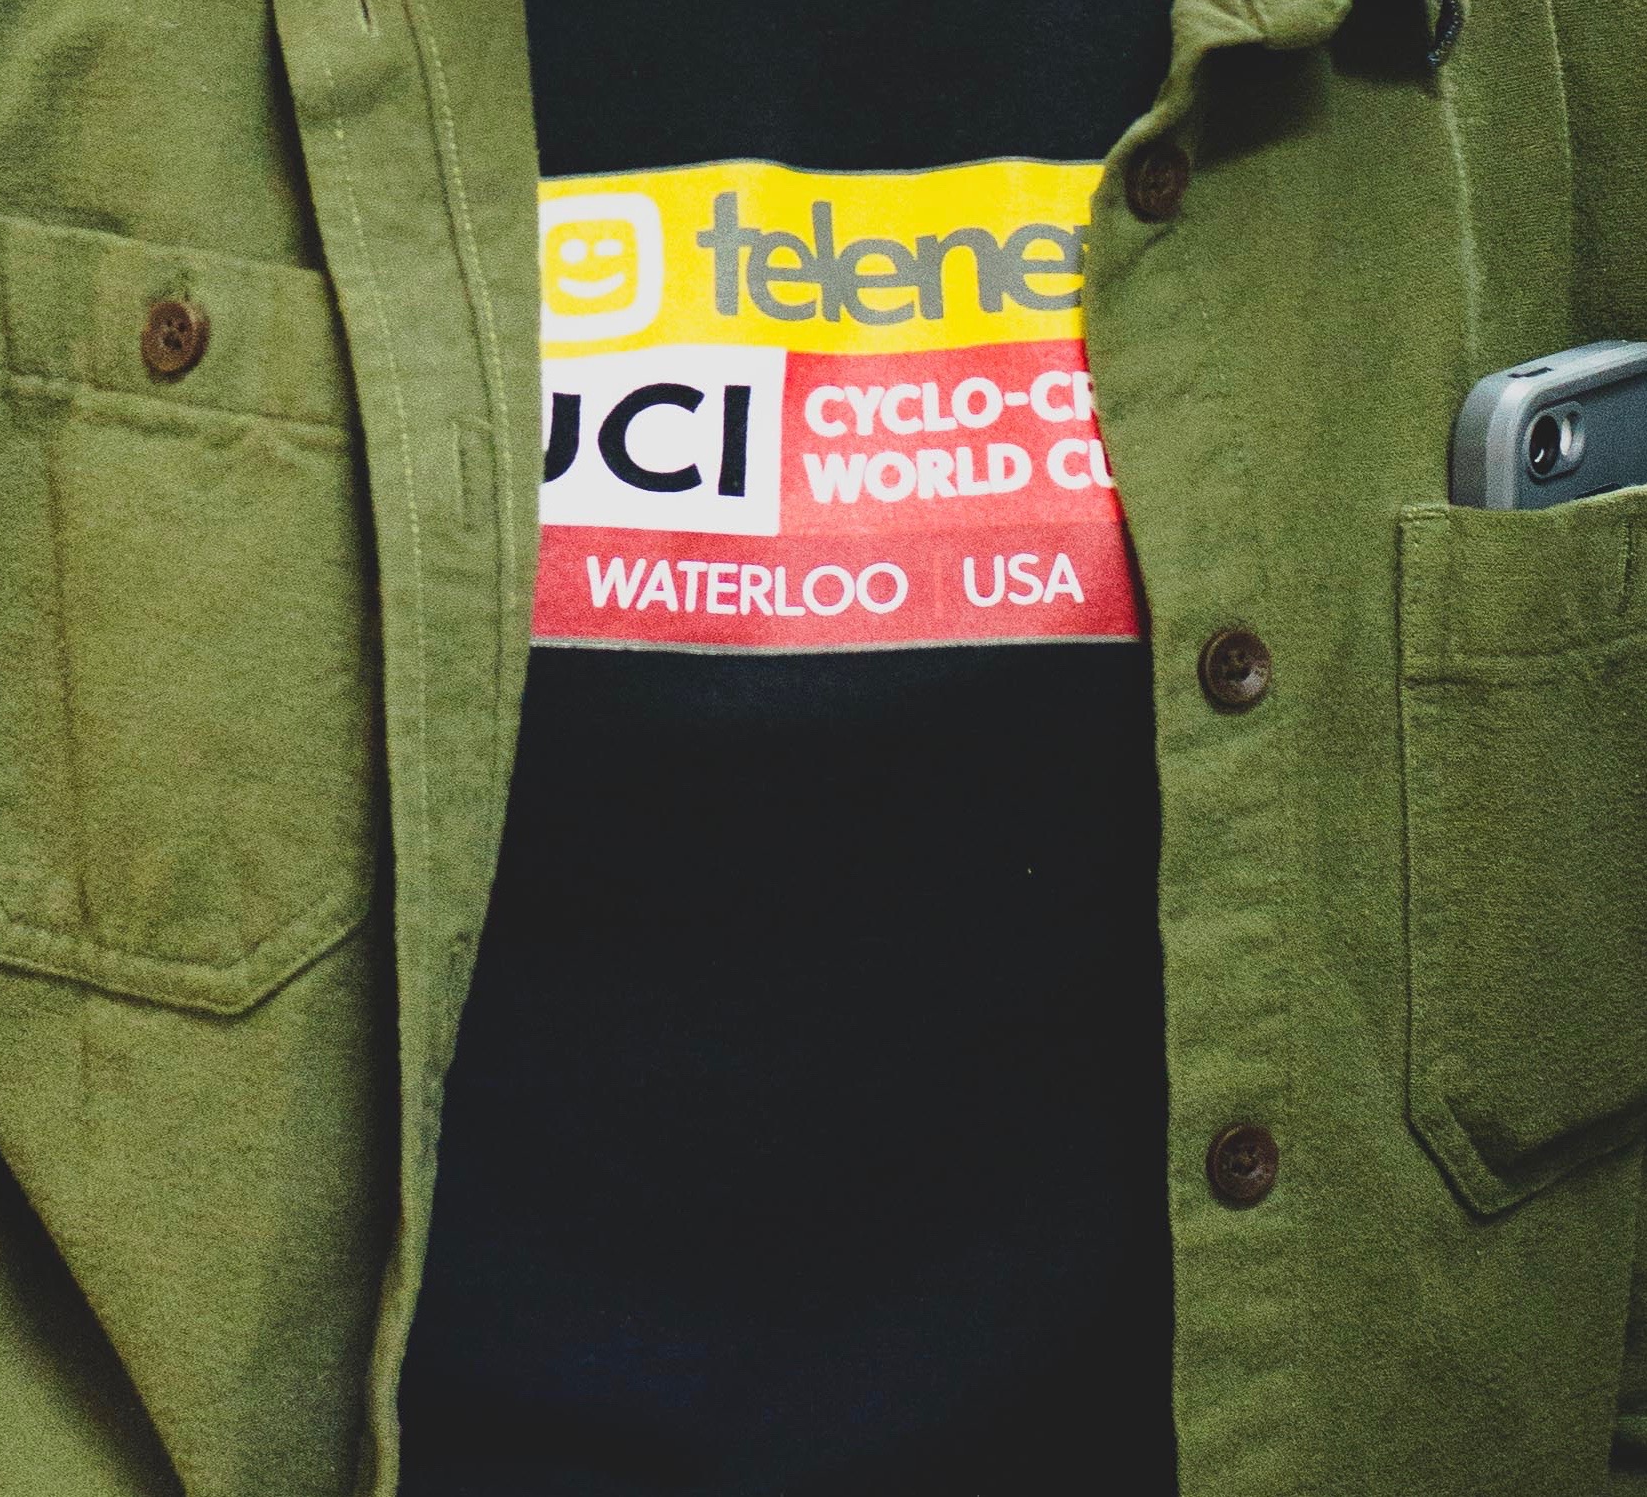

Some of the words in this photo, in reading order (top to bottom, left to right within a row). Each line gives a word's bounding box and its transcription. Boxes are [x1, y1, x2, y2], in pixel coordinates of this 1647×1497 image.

[695, 190, 1090, 326] telene
[803, 442, 1032, 504] WORLD
[585, 554, 910, 616] WATERLOO
[962, 552, 1085, 608] USA
